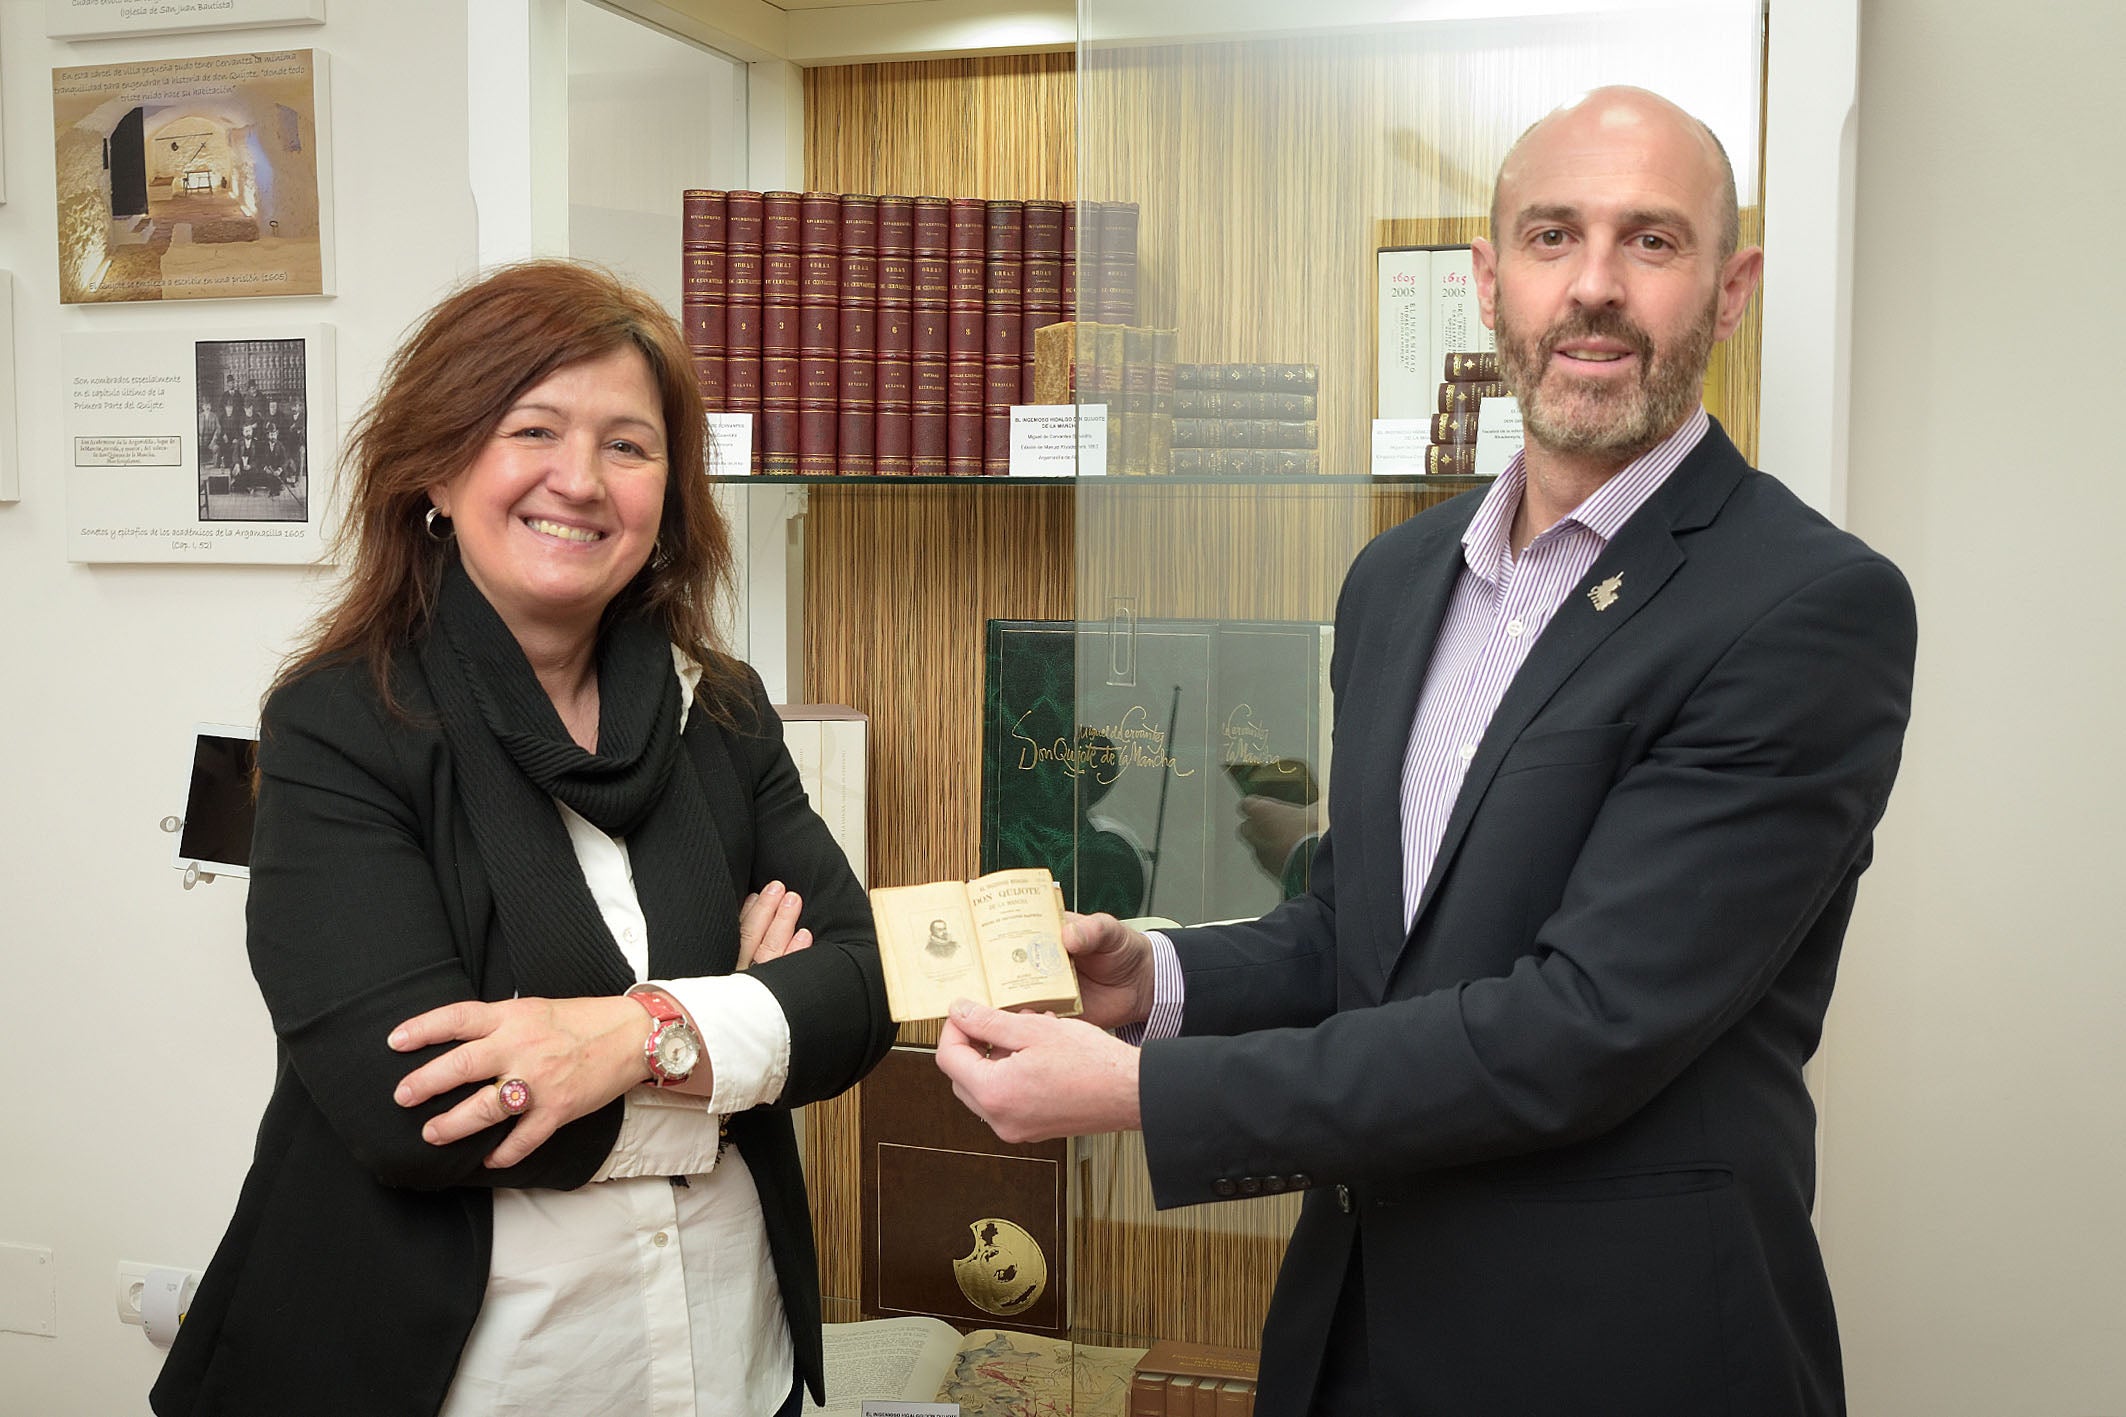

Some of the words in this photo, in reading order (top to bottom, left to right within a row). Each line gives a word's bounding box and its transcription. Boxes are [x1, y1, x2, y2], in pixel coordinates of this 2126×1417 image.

[160, 5, 175, 14] San
[198, 1, 234, 11] Bautista)
[1392, 272, 1415, 285] 1605
[1391, 287, 1415, 297] 2005
[1442, 287, 1466, 297] 2005
[701, 320, 707, 329] 1
[741, 322, 747, 331] 2
[779, 321, 785, 330] 3
[816, 322, 823, 332] 4
[891, 325, 898, 335] 6
[927, 326, 933, 336] 7
[965, 328, 971, 337] 8
[73, 377, 89, 385] Son
[110, 529, 117, 540] y
[150, 528, 158, 536] de
[215, 529, 224, 537] de
[235, 529, 282, 540] Argamasilla
[283, 529, 305, 538] 1605
[1012, 716, 1054, 769] Don
[1053, 737, 1099, 777] Quijote
[1100, 748, 1115, 766] de
[1113, 741, 1194, 780] Mancha
[972, 894, 993, 907] DON
[998, 886, 1040, 898] QUIJOTE
